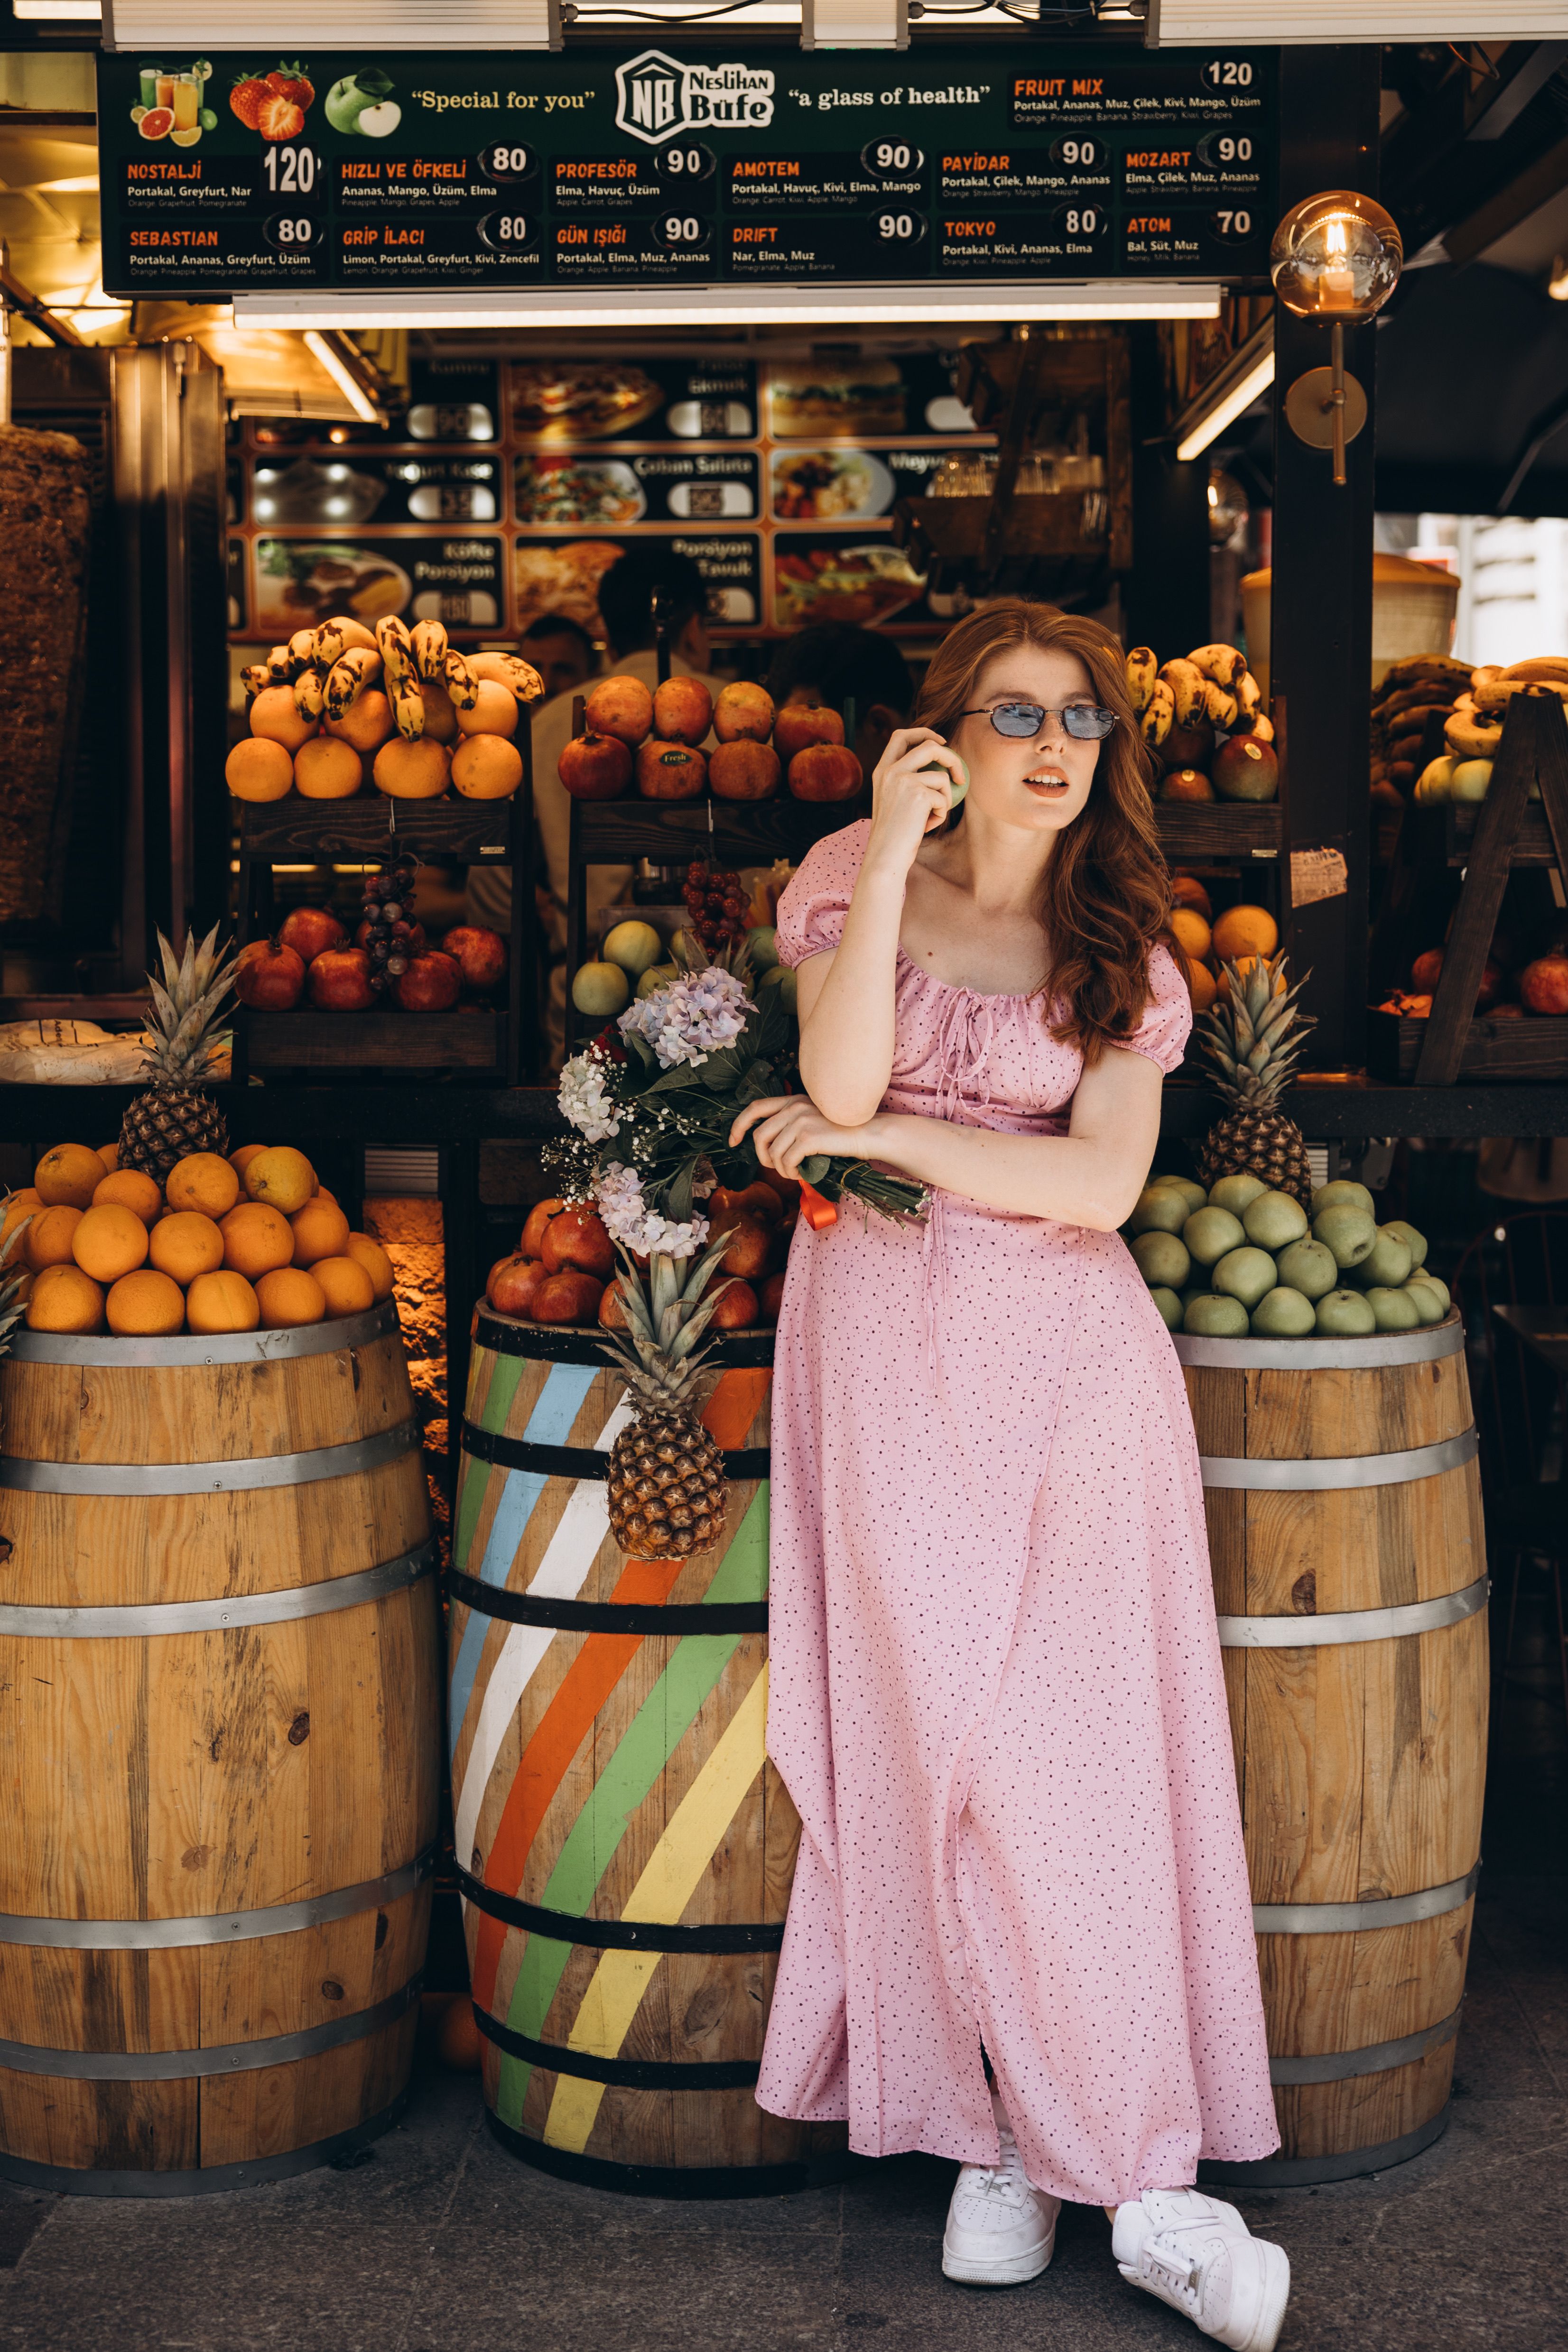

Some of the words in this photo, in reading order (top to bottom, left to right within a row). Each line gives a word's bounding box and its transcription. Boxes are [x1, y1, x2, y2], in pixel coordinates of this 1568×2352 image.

[1209, 61, 1252, 85] 120
[1015, 79, 1065, 96] FRUIT
[1073, 79, 1103, 95] MIX
[507, 91, 538, 108] for
[690, 93, 767, 121] Büfe
[818, 89, 873, 110] glass
[881, 87, 903, 105] of
[1014, 100, 1059, 111] Portakal,
[1063, 101, 1103, 110] Ananas,
[1106, 99, 1131, 109] Muz,
[1133, 98, 1161, 109] Çilek,
[1165, 97, 1186, 108] Kivi,
[1189, 98, 1228, 109] Mango,
[1231, 95, 1260, 107] Üzüm
[877, 144, 909, 168] 90
[1063, 141, 1094, 165] 90
[1219, 138, 1251, 160] 90
[493, 148, 526, 171] 80
[668, 150, 700, 173] 90
[943, 152, 1009, 171] PAYİDAR
[1127, 152, 1191, 167] MOZART
[128, 160, 201, 179] NOSTALJİ
[265, 147, 314, 193] 120
[342, 164, 380, 178] HIZLI
[386, 163, 406, 178] VE
[413, 159, 466, 178] ÖFKELİ
[557, 159, 637, 178] PROFESÖR
[733, 161, 799, 176] AMOTEM
[942, 176, 990, 187] Portakal,
[993, 176, 1022, 188] Çilek,
[1027, 176, 1067, 188] Mango,
[1071, 176, 1110, 185] Ananas
[1126, 173, 1154, 184] Elma,
[1158, 172, 1187, 184] Çilek,
[1191, 172, 1216, 183] Muz,
[1220, 172, 1259, 182] Ananas
[128, 186, 176, 197] Portakal,
[179, 186, 227, 199] Greyfurt,
[232, 186, 251, 195] Nar
[343, 186, 384, 196] Ananas,
[389, 185, 429, 198] Mango,
[433, 184, 467, 196] Üzüm,
[471, 185, 496, 195] Elma
[556, 185, 585, 196] Elma,
[589, 186, 625, 197] Havuç,
[629, 184, 659, 195] Üzüm
[733, 183, 780, 194] Portakal,
[784, 183, 820, 195] Havuç,
[824, 182, 846, 193] Kivi,
[850, 182, 879, 192] Elma,
[882, 181, 920, 194] Mango
[500, 217, 525, 240] 80
[666, 218, 698, 241] 90
[880, 215, 912, 237] 90
[945, 221, 995, 236] TOKYO
[1067, 210, 1095, 232] 80
[1128, 218, 1170, 233] ATOM
[1217, 211, 1250, 233] 70
[131, 231, 217, 246] SEBASTIAN
[279, 219, 311, 241] 80
[343, 226, 378, 245] GRİP
[384, 225, 424, 244] İLACI
[557, 225, 587, 243] GÜN
[594, 224, 626, 247] IŞIĞI
[733, 227, 778, 242] DRIFT
[943, 245, 991, 255] Portakal,
[994, 244, 1017, 254] Kivi,
[1021, 244, 1063, 254] Ananas,
[1067, 243, 1092, 253] Elma
[1128, 241, 1147, 251] Bal,
[1150, 241, 1171, 250] Süt,
[1175, 241, 1198, 250] Muz
[130, 255, 177, 265] Portakal,
[182, 255, 223, 265] Ananas,
[227, 254, 275, 267] Greyfurt,
[279, 252, 310, 264] Üzüm
[343, 255, 376, 265] Limon,
[380, 254, 424, 264] Portakal,
[427, 254, 472, 266] Greyfurt,
[475, 254, 496, 264] Kivi,
[500, 254, 539, 263] Zencefil
[557, 253, 604, 263] Portakal,
[609, 253, 637, 263] Elma,
[641, 253, 667, 263] Muz,
[670, 252, 710, 261] Ananas
[733, 252, 755, 262] Nar,
[759, 251, 787, 261] Elma,
[791, 250, 814, 260] Muz
[665, 754, 686, 762] Fresh
